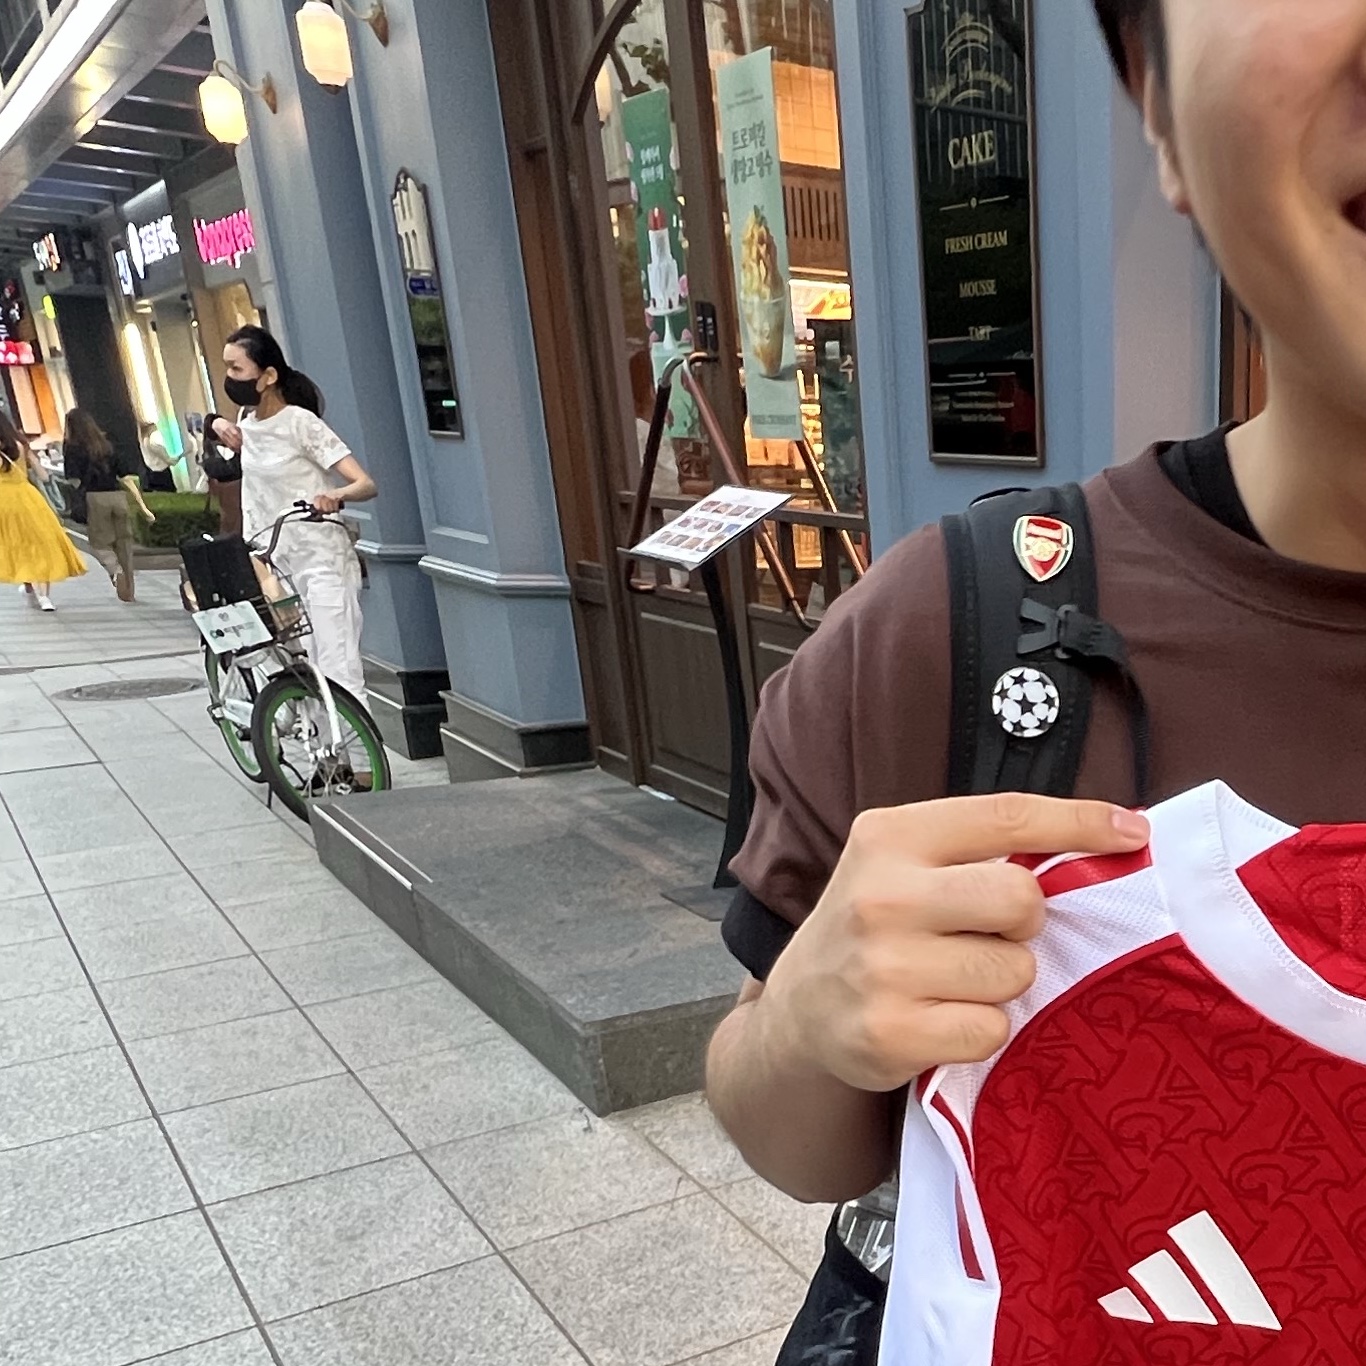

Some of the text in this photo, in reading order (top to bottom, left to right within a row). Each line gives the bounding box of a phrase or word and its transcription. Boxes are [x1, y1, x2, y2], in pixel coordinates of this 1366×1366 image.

[949, 130, 995, 169] CAKE
[945, 230, 1008, 254] FRESH CREAM
[960, 280, 997, 298] MOUSSE
